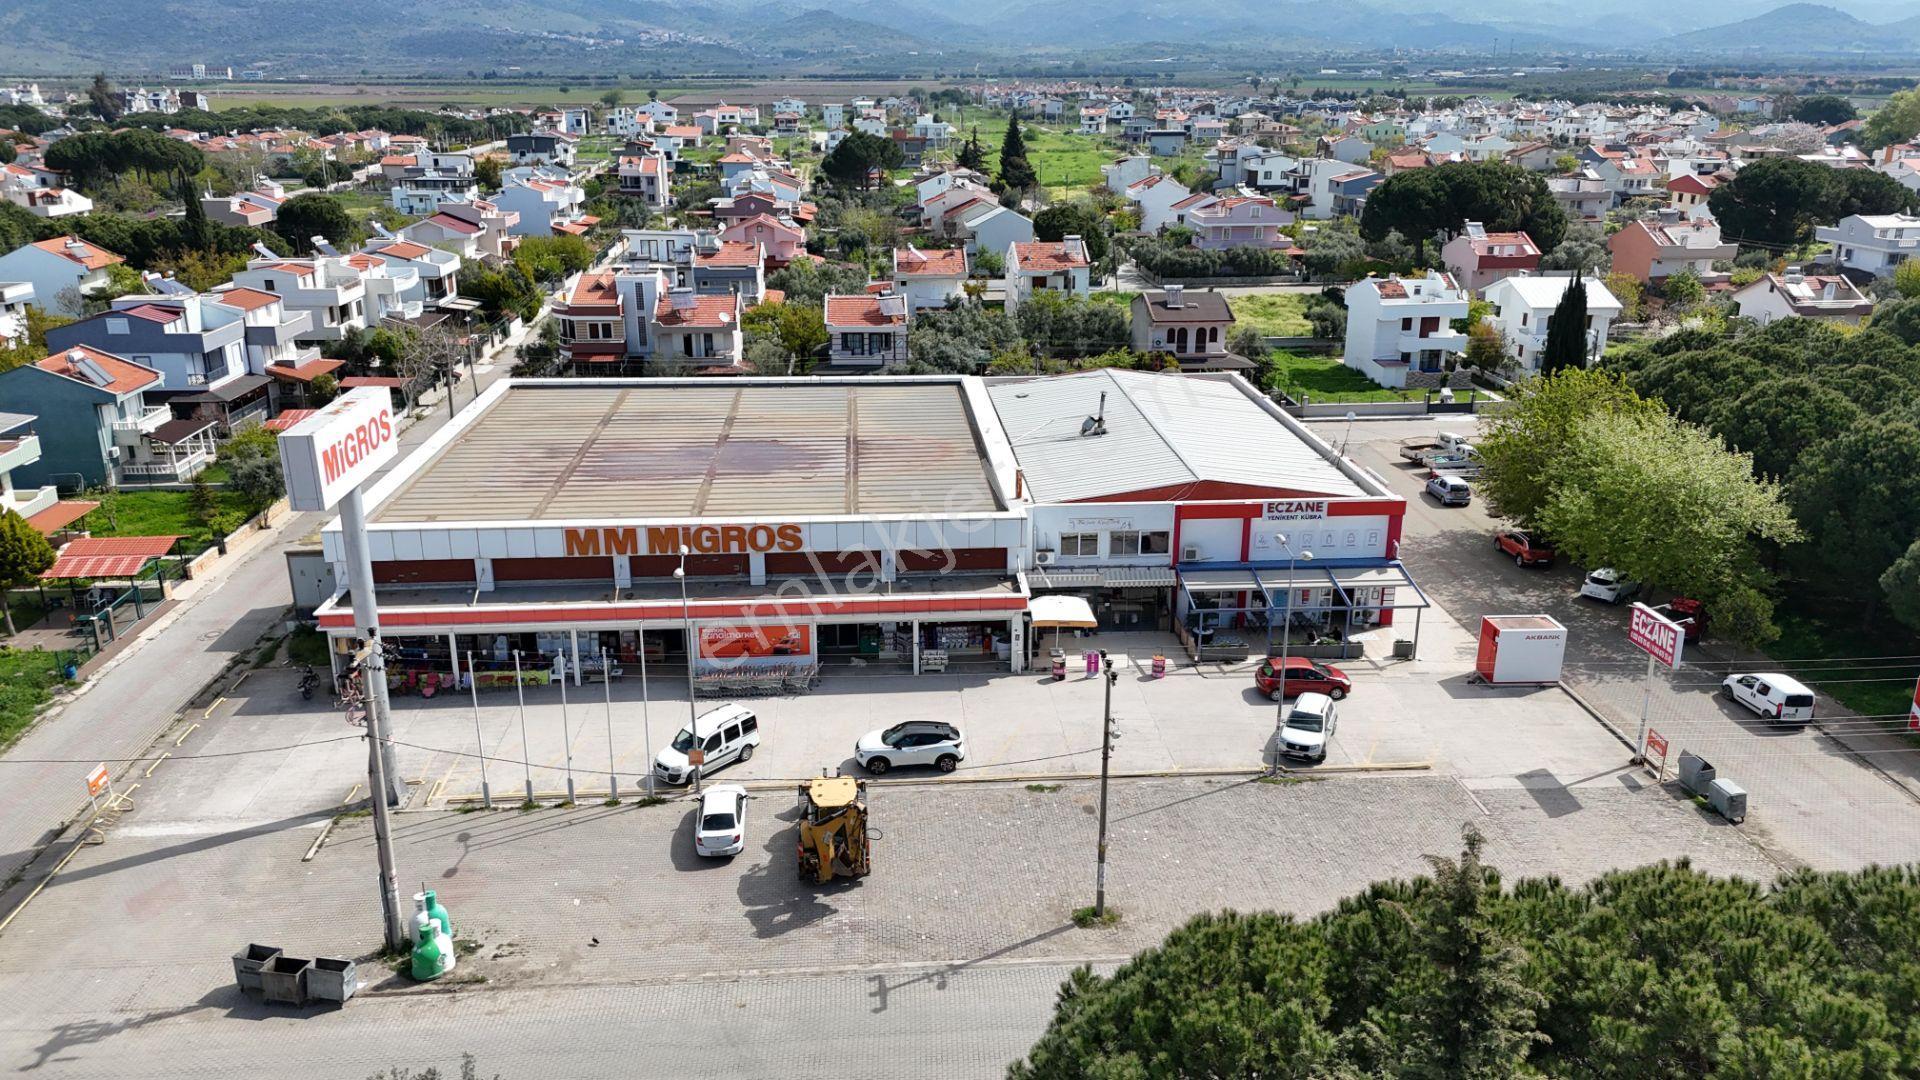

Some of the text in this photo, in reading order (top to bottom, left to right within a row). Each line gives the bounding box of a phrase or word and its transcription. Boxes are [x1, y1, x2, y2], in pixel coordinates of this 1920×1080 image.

[1267, 502, 1324, 513] ECZANE
[564, 527, 639, 556] MM
[1631, 609, 1676, 655] ECZANE
